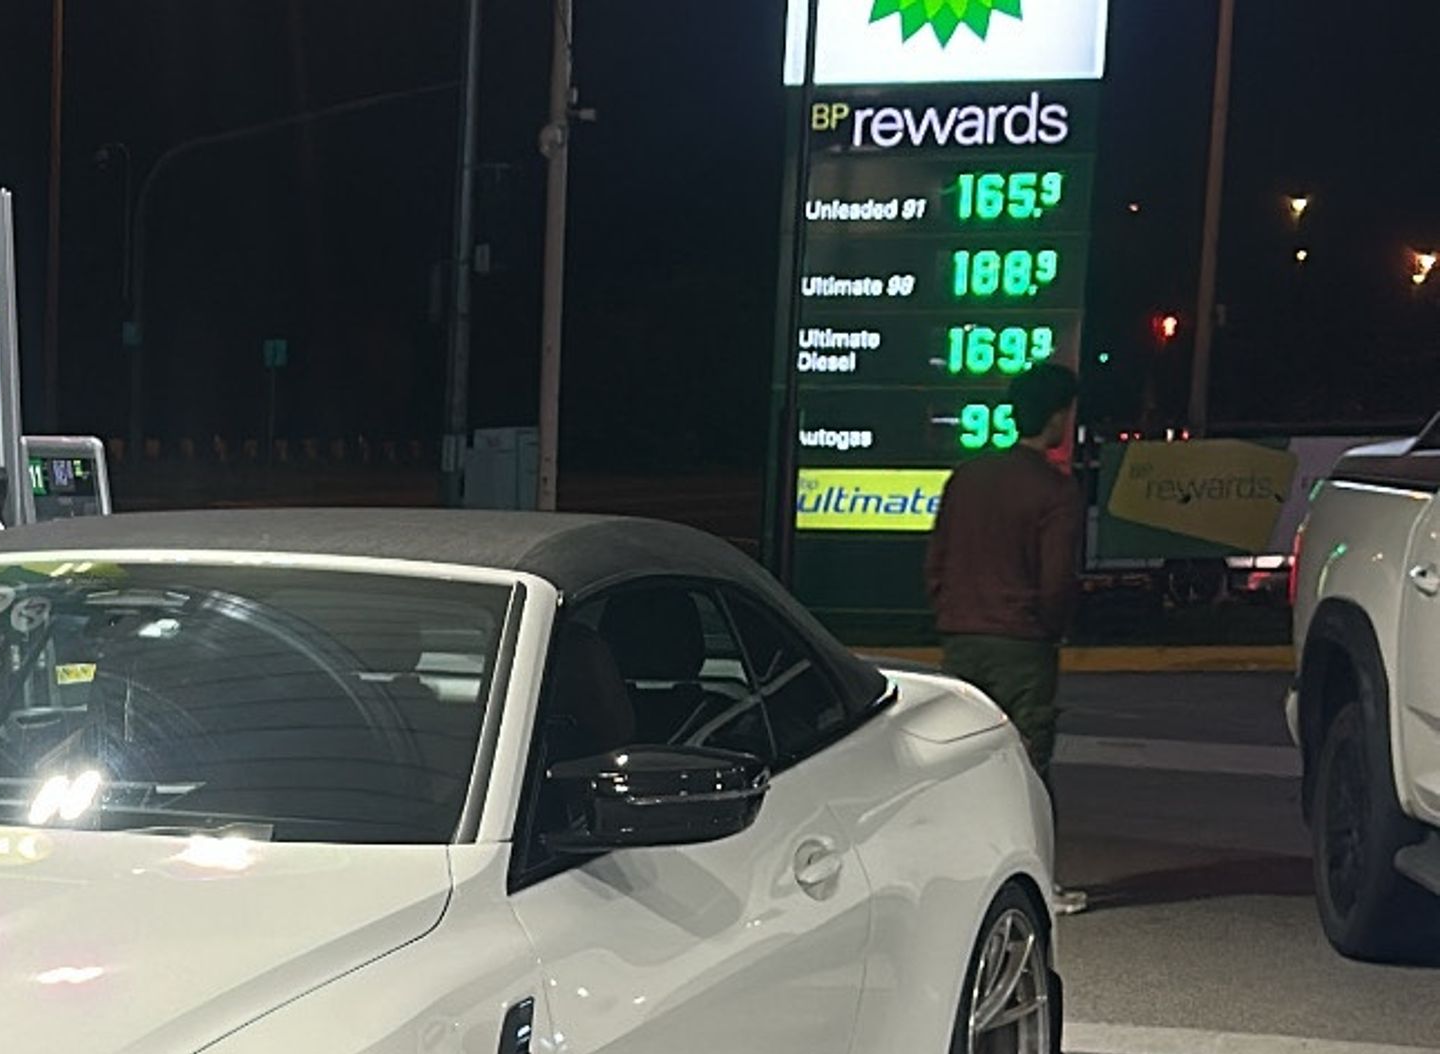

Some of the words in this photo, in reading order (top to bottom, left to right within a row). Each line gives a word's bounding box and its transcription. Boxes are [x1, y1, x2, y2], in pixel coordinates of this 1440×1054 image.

[811, 103, 849, 131] BP
[852, 91, 1069, 148] rewards
[958, 171, 1063, 219] 165.9
[805, 199, 898, 220] Unleaded
[901, 199, 927, 220] 91
[801, 276, 883, 297] Ultimate
[798, 328, 881, 349] Ultimate
[796, 351, 856, 373] Diesel
[798, 428, 873, 450] utogas
[1146, 468, 1273, 499] rewards
